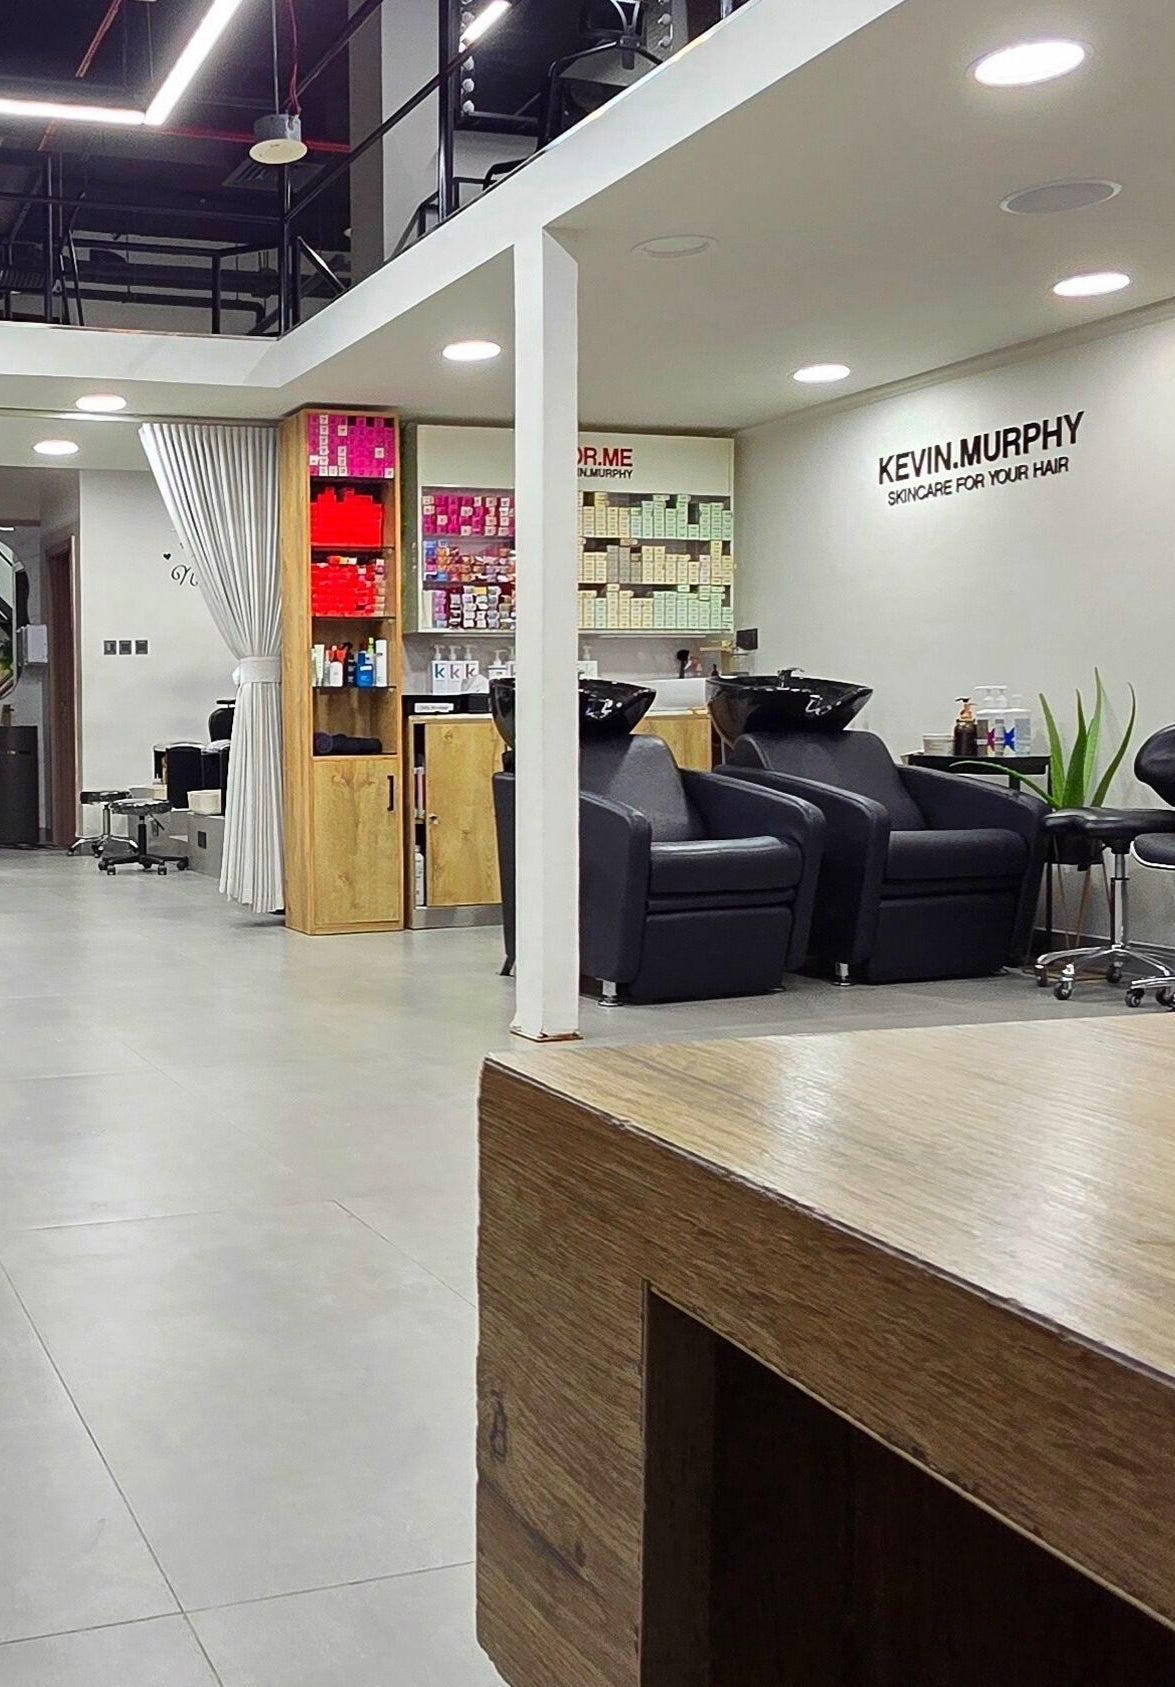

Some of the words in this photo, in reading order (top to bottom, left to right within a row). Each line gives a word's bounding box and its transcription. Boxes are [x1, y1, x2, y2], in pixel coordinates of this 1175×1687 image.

[878, 410, 1085, 485] KEVIN.MURPHY
[888, 479, 952, 506] SKINCARE
[956, 473, 984, 493] FOR
[988, 464, 1029, 486] YOUR
[1033, 456, 1069, 478] HAIR
